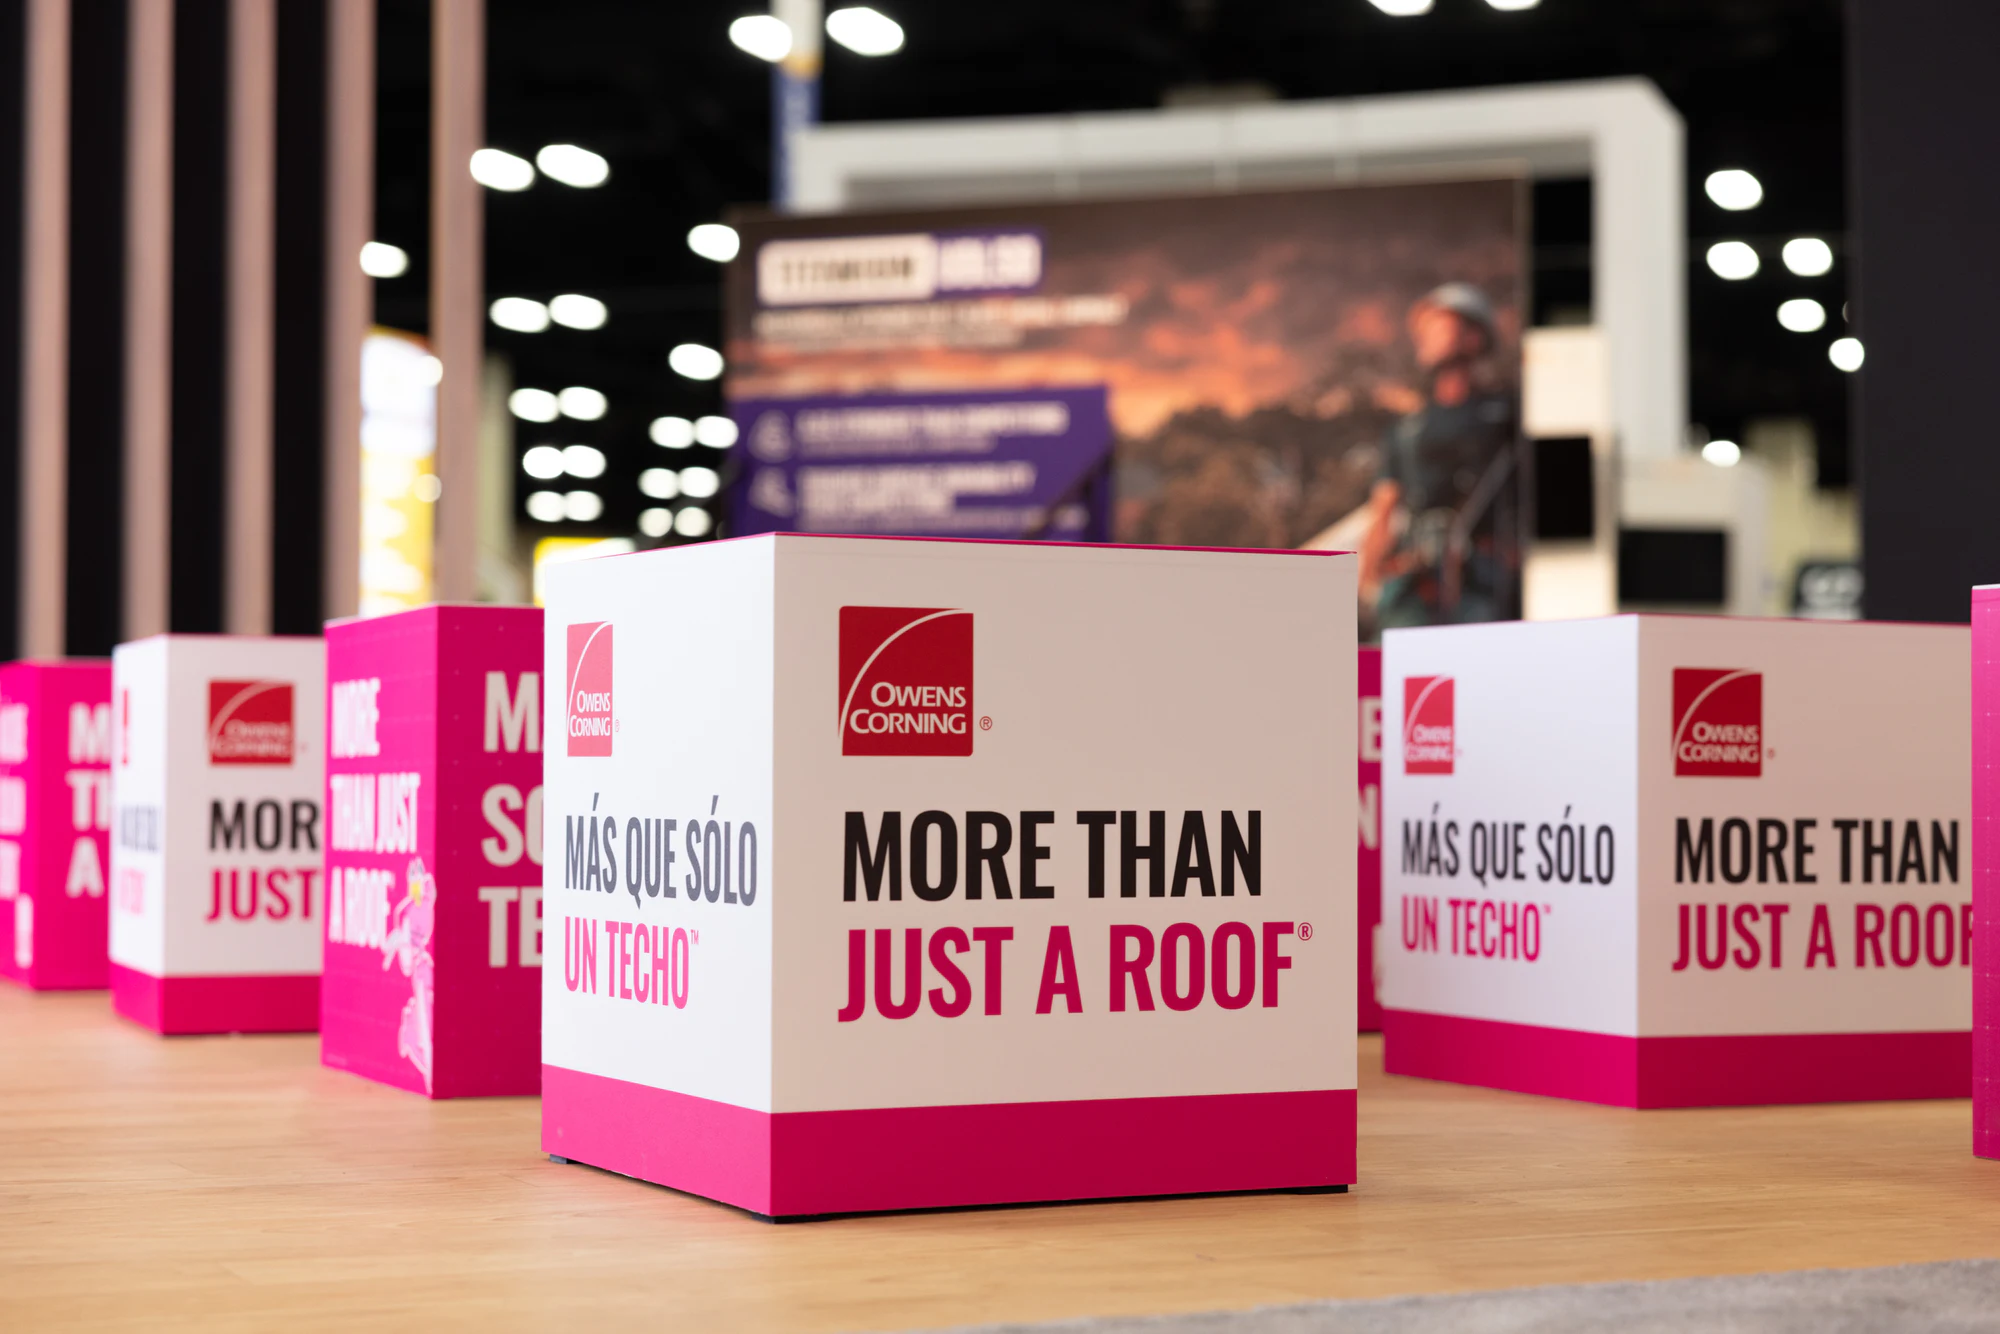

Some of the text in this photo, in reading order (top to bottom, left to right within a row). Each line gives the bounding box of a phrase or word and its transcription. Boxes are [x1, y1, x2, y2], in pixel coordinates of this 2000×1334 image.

[569, 714, 611, 737] CORNING
[576, 690, 611, 713] OWENS
[849, 709, 967, 735] CORNING
[870, 682, 967, 708] OWENS
[1692, 720, 1760, 743] OWENS
[209, 797, 320, 853] MOR
[376, 772, 421, 854] JUST
[1401, 801, 1615, 889] MÁS QUE SÓLO
[564, 792, 758, 910] MÁS QUE SÓLO
[842, 809, 1262, 902] MORE THAN
[1674, 816, 1959, 885] MORE THAN
[205, 866, 321, 924] JUST
[329, 866, 343, 943] A
[478, 886, 543, 968] TE
[1401, 894, 1439, 954] UN
[564, 915, 598, 995] UN
[1671, 902, 1790, 972] JUST
[1804, 902, 1837, 969] A
[837, 925, 1014, 1023] JUST
[1035, 925, 1084, 1015] A
